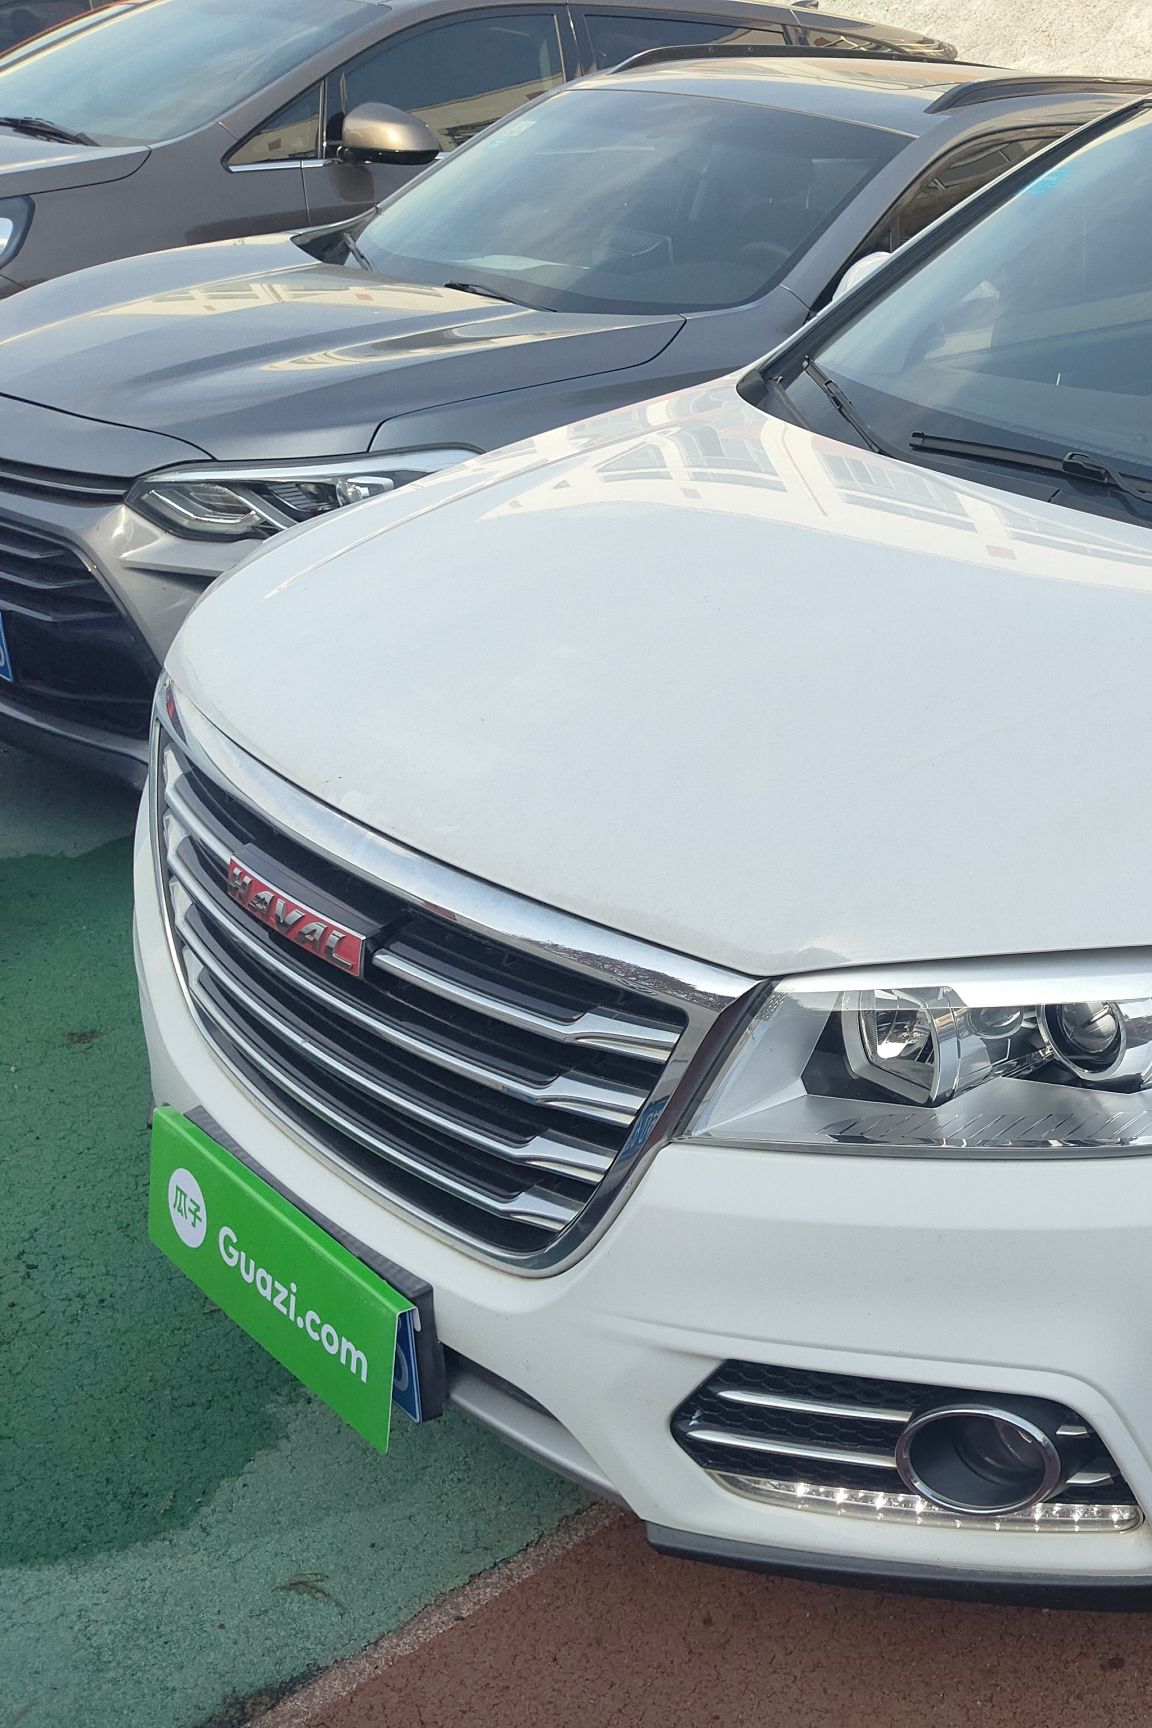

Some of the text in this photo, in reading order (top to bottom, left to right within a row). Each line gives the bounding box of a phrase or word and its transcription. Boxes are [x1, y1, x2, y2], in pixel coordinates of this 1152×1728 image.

[229, 866, 353, 969] HAVAL
[173, 1185, 203, 1229] 瓜子
[218, 1226, 368, 1383] Guazi.com
